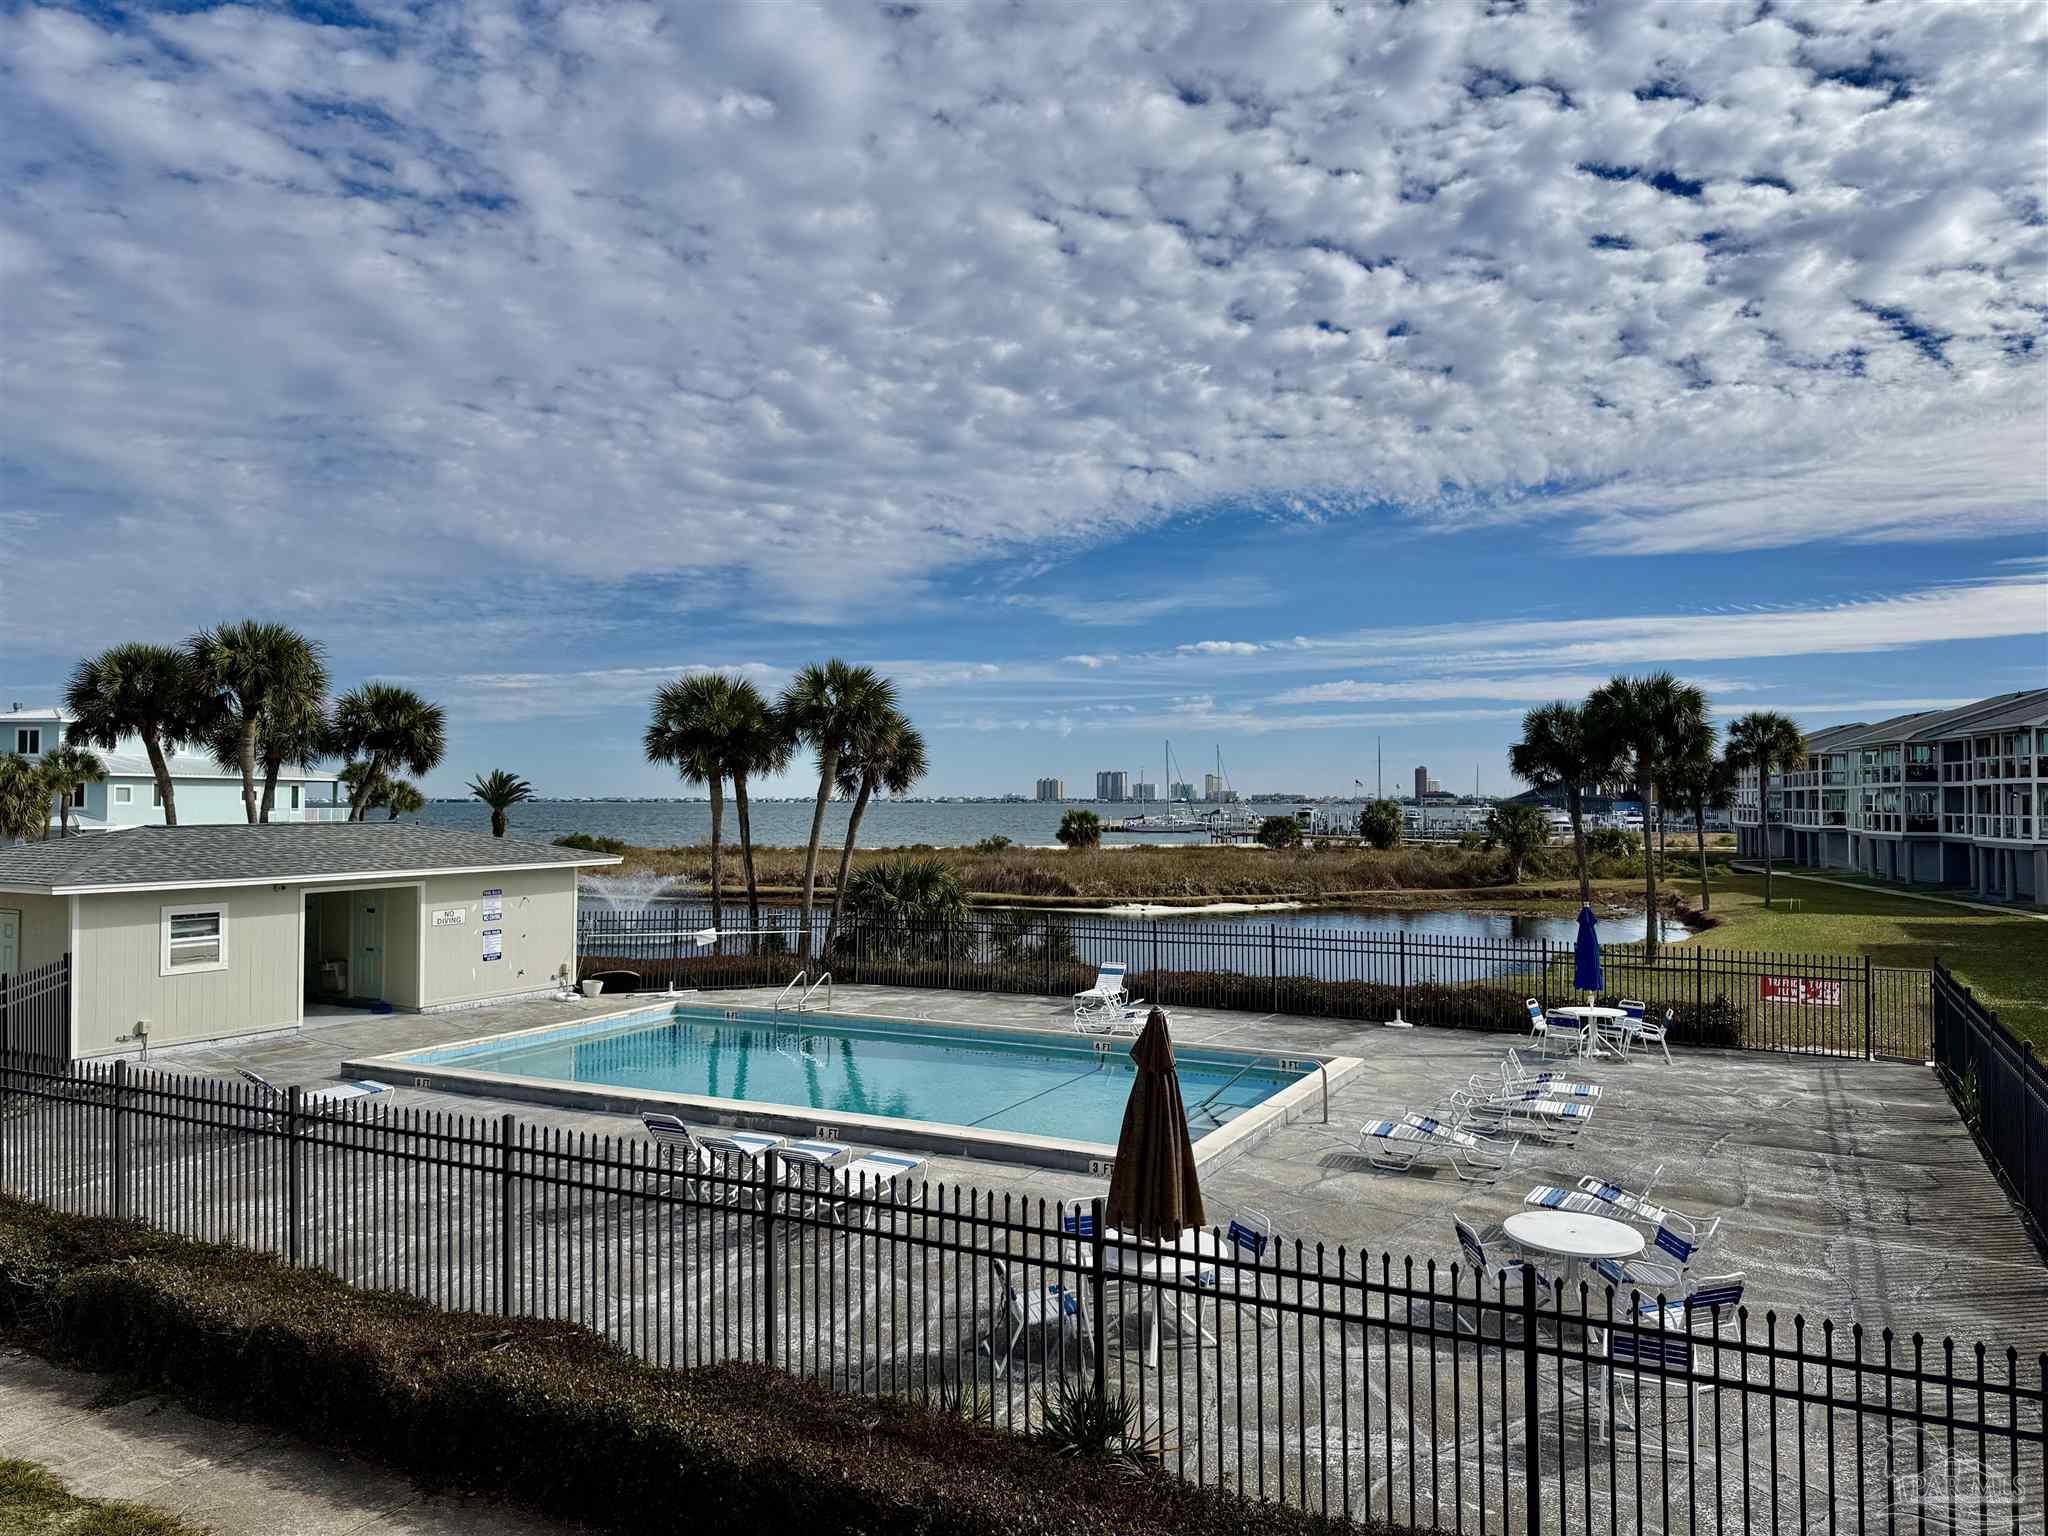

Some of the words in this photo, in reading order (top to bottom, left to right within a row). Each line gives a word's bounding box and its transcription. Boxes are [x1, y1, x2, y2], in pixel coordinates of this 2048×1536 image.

[437, 917, 462, 925] DIVING
[818, 1127, 824, 1138] 4
[828, 1128, 838, 1139] FT
[1092, 1162, 1099, 1173] 3
